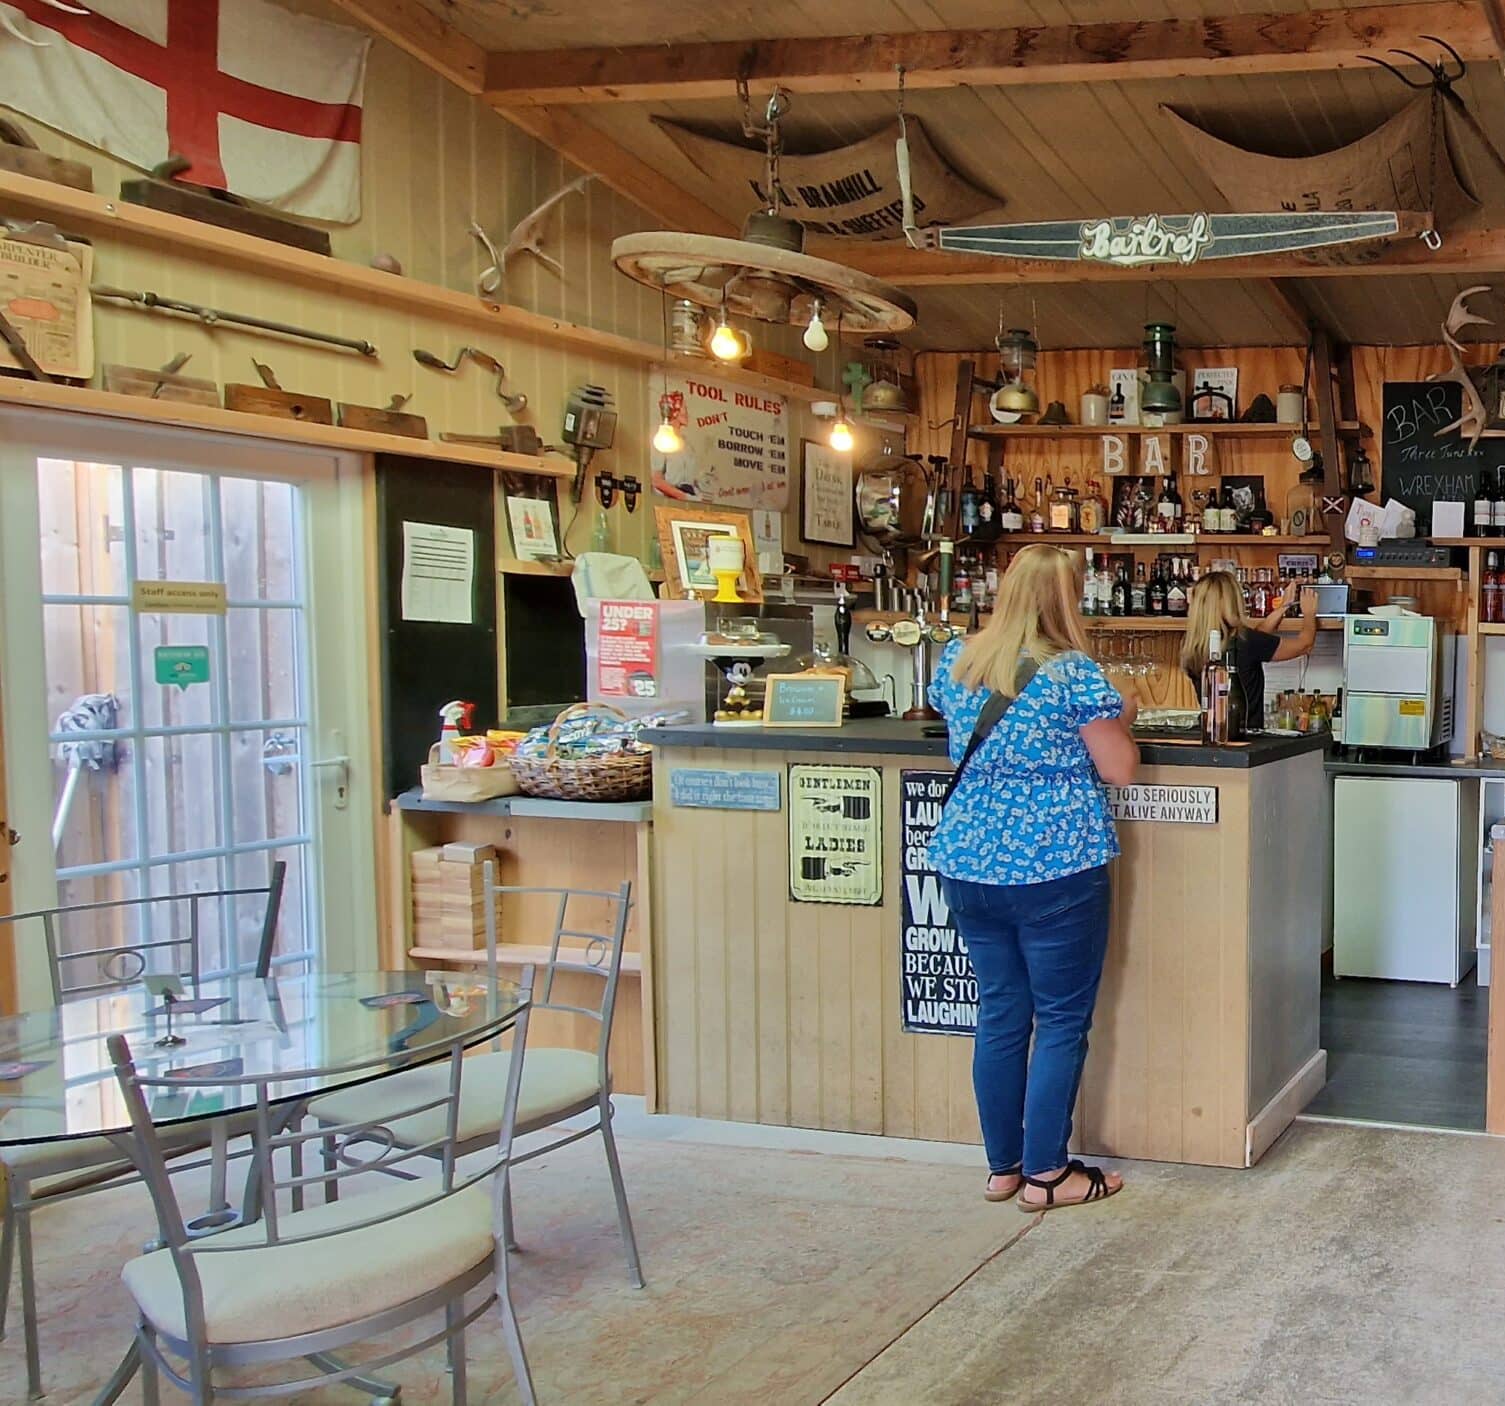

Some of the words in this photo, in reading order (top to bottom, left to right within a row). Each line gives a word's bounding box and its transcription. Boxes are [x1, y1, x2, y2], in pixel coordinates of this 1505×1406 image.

[797, 169, 882, 208] BRAMHILL
[843, 193, 926, 235] SHEFFIED
[1083, 215, 1208, 262] Bartref
[687, 381, 728, 403] TOOL
[735, 393, 784, 415] RULES
[697, 412, 728, 428] DON'T
[1387, 386, 1453, 445] BAR
[728, 426, 763, 441] TOUCH
[768, 433, 785, 446] 'EM
[718, 440, 763, 457] BORROW
[768, 449, 785, 460] 'EM
[1102, 434, 1209, 475] BAR
[734, 459, 763, 471] MOVE
[768, 463, 785, 475] 'EM
[1399, 474, 1478, 497] WREXHAM
[141, 587, 164, 597] Staff
[602, 605, 654, 619] UNDER
[602, 618, 628, 631] 25?
[799, 777, 870, 792] GENTLEMEN
[906, 782, 925, 797] we
[1116, 787, 1138, 801] TOO
[906, 801, 943, 827] LAU
[1124, 805, 1157, 819] ALIVE
[805, 836, 865, 853] LADIES
[906, 927, 956, 953] GROW
[905, 976, 937, 999] WE
[943, 978, 979, 1002] STO
[907, 1000, 980, 1027] LAUGHIN
